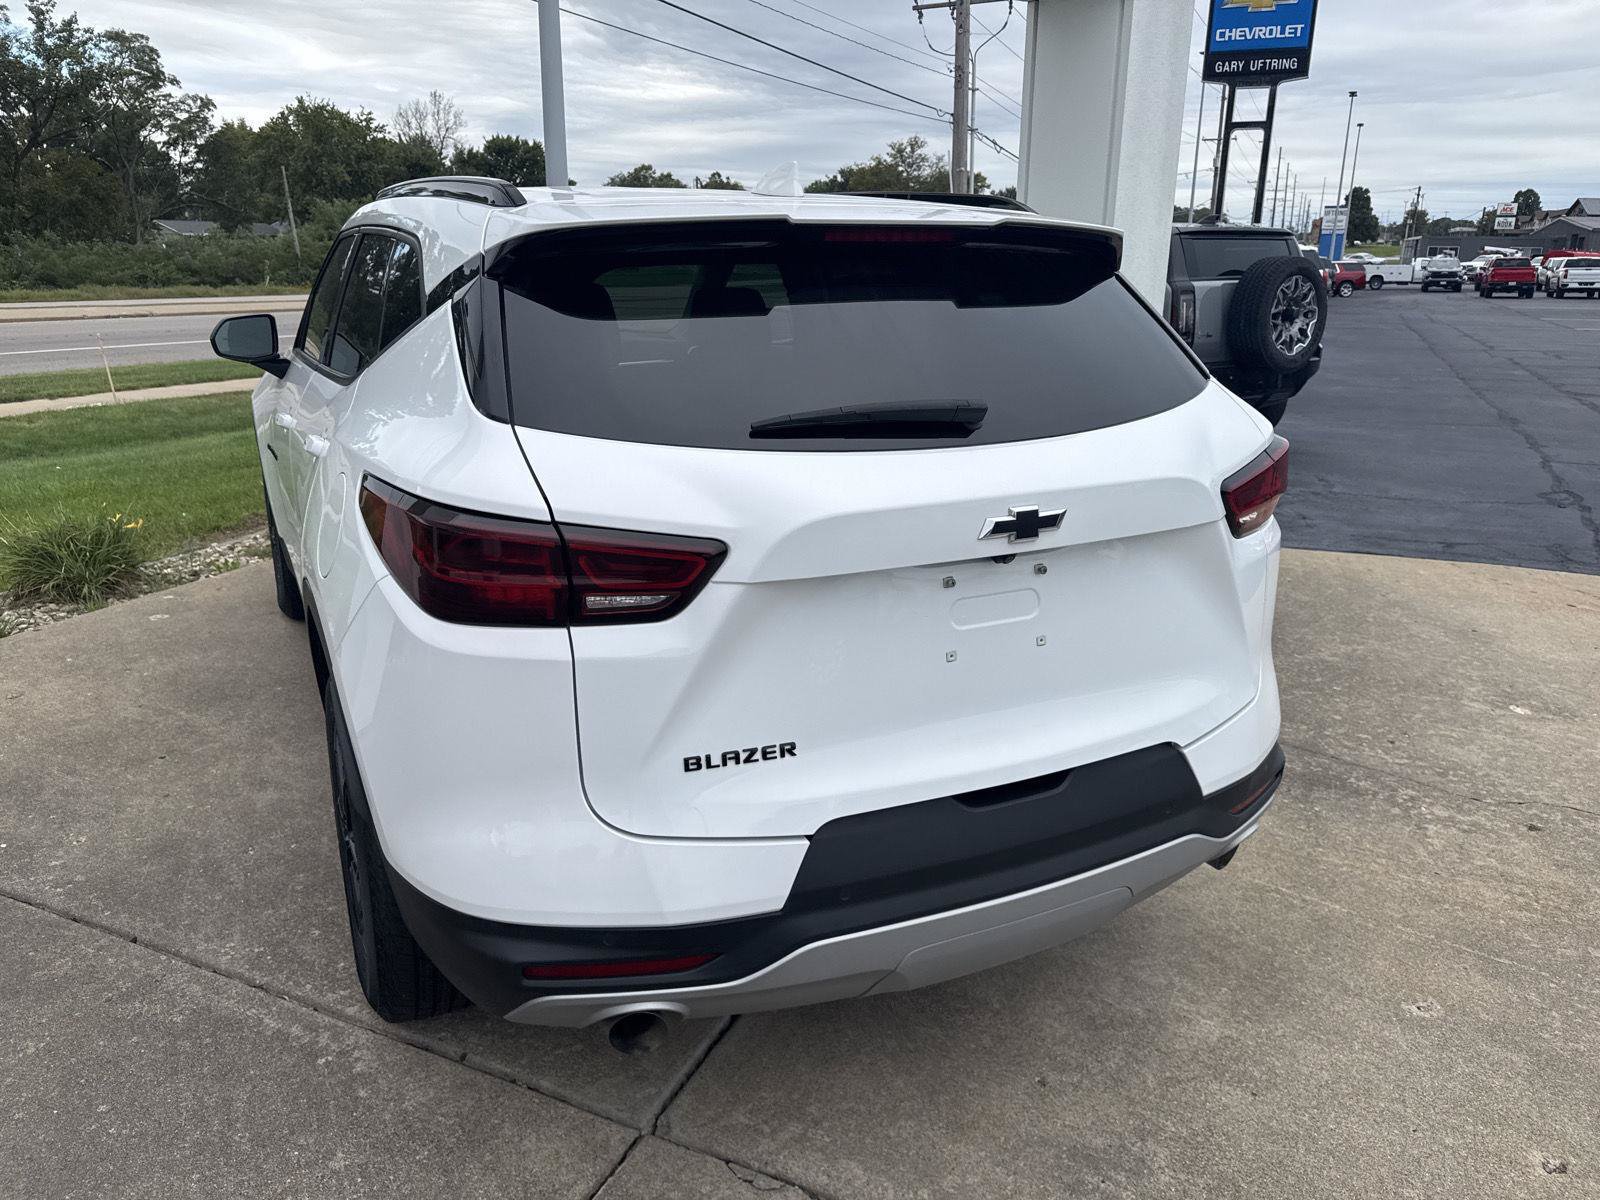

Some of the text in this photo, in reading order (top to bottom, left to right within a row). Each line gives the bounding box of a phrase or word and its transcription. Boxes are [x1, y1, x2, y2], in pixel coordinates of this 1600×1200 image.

[1215, 24, 1304, 42] CHEVROLET
[1215, 57, 1298, 73] GARY UFTRING
[683, 741, 797, 772] BLAZER
